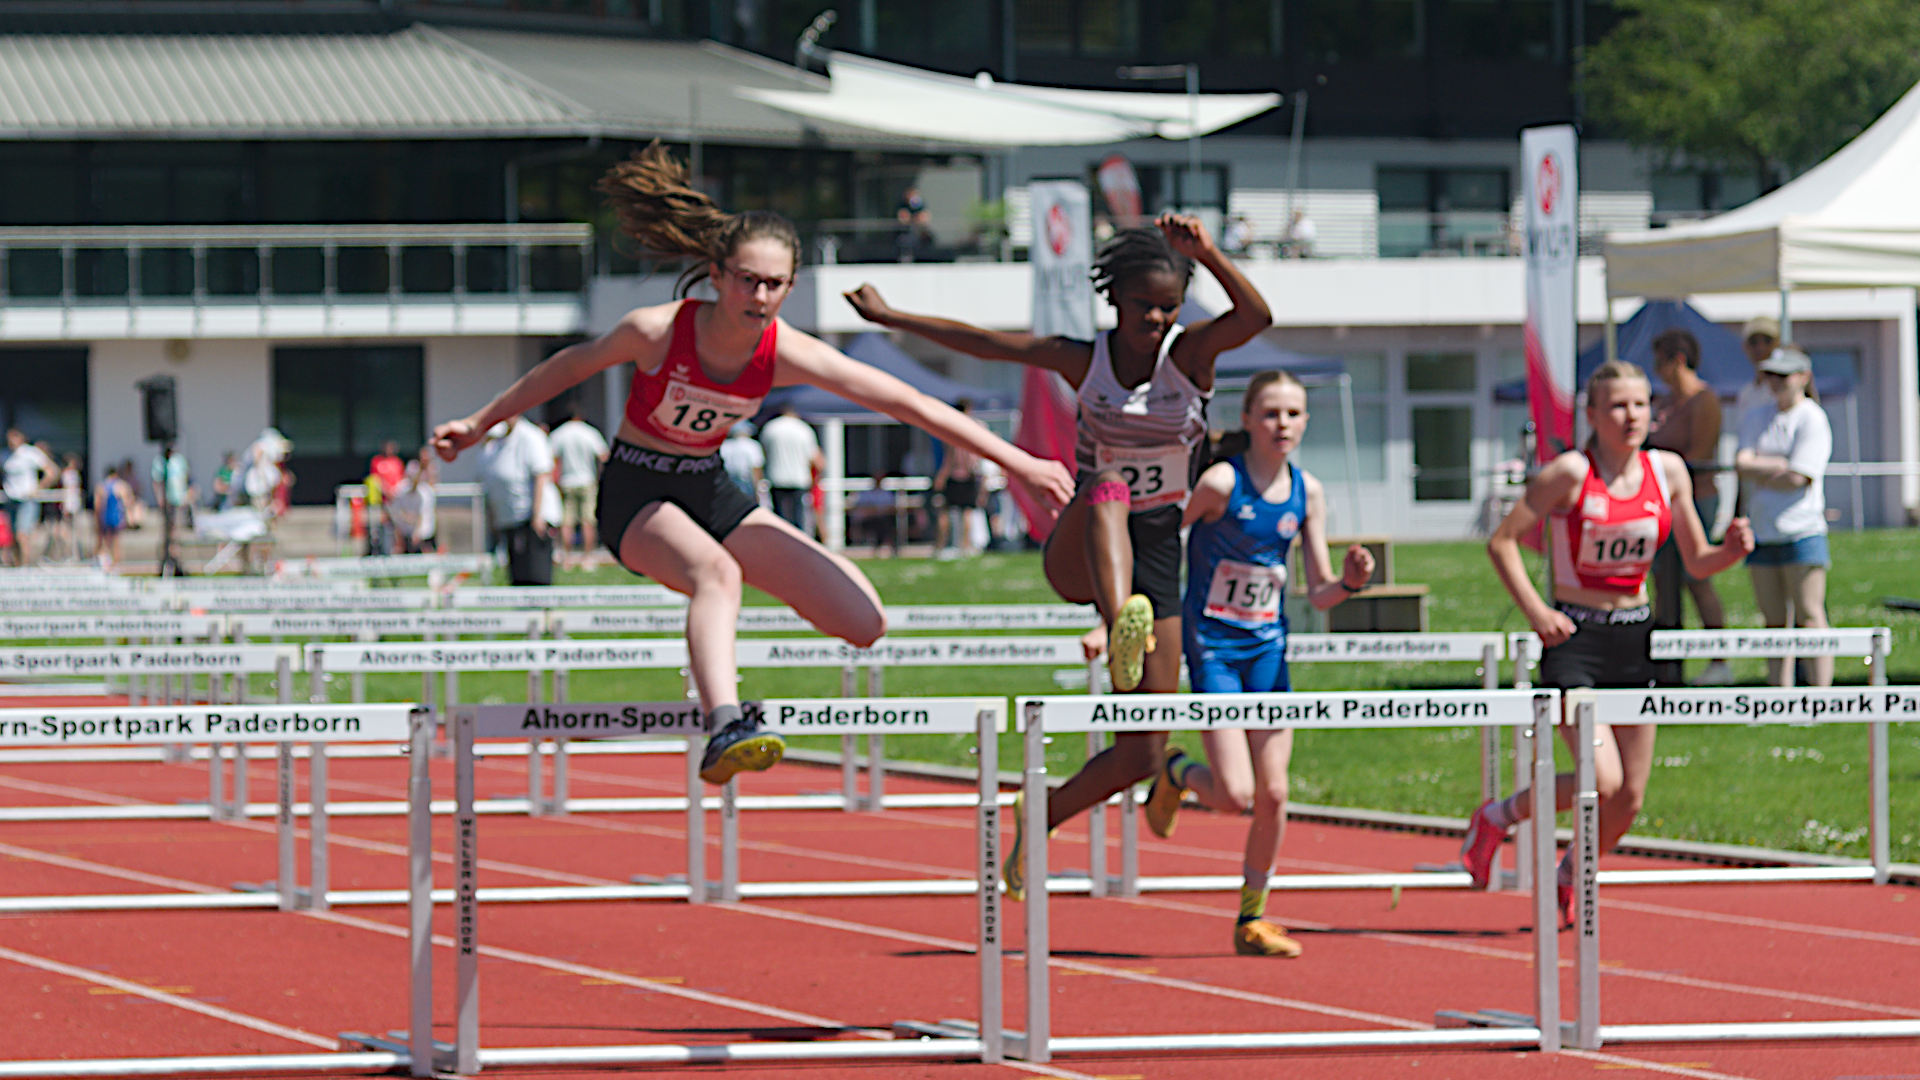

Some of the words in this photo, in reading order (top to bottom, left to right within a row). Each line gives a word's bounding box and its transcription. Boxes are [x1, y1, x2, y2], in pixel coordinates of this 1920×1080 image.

[672, 404, 743, 432] 187
[613, 445, 677, 473] NIKE
[1121, 466, 1164, 496] 23
[1594, 537, 1647, 561] 104
[1224, 579, 1275, 607] 150
[360, 649, 536, 670] Ahorn-Sportpark
[546, 647, 654, 663] Paderborn
[768, 644, 940, 664] Ahorn-Sportpark
[949, 643, 1056, 658] Paderborn
[1345, 640, 1451, 653] Paderborn
[131, 651, 241, 667] Paderborn
[780, 705, 929, 726] Paderborn
[1091, 700, 1331, 725] Ahorn-Sportpark
[1343, 698, 1488, 719] Paderborn
[1639, 693, 1875, 718] Ahorn-Sportpark
[1885, 693, 1920, 713] Pa
[206, 712, 361, 734] Paderborn
